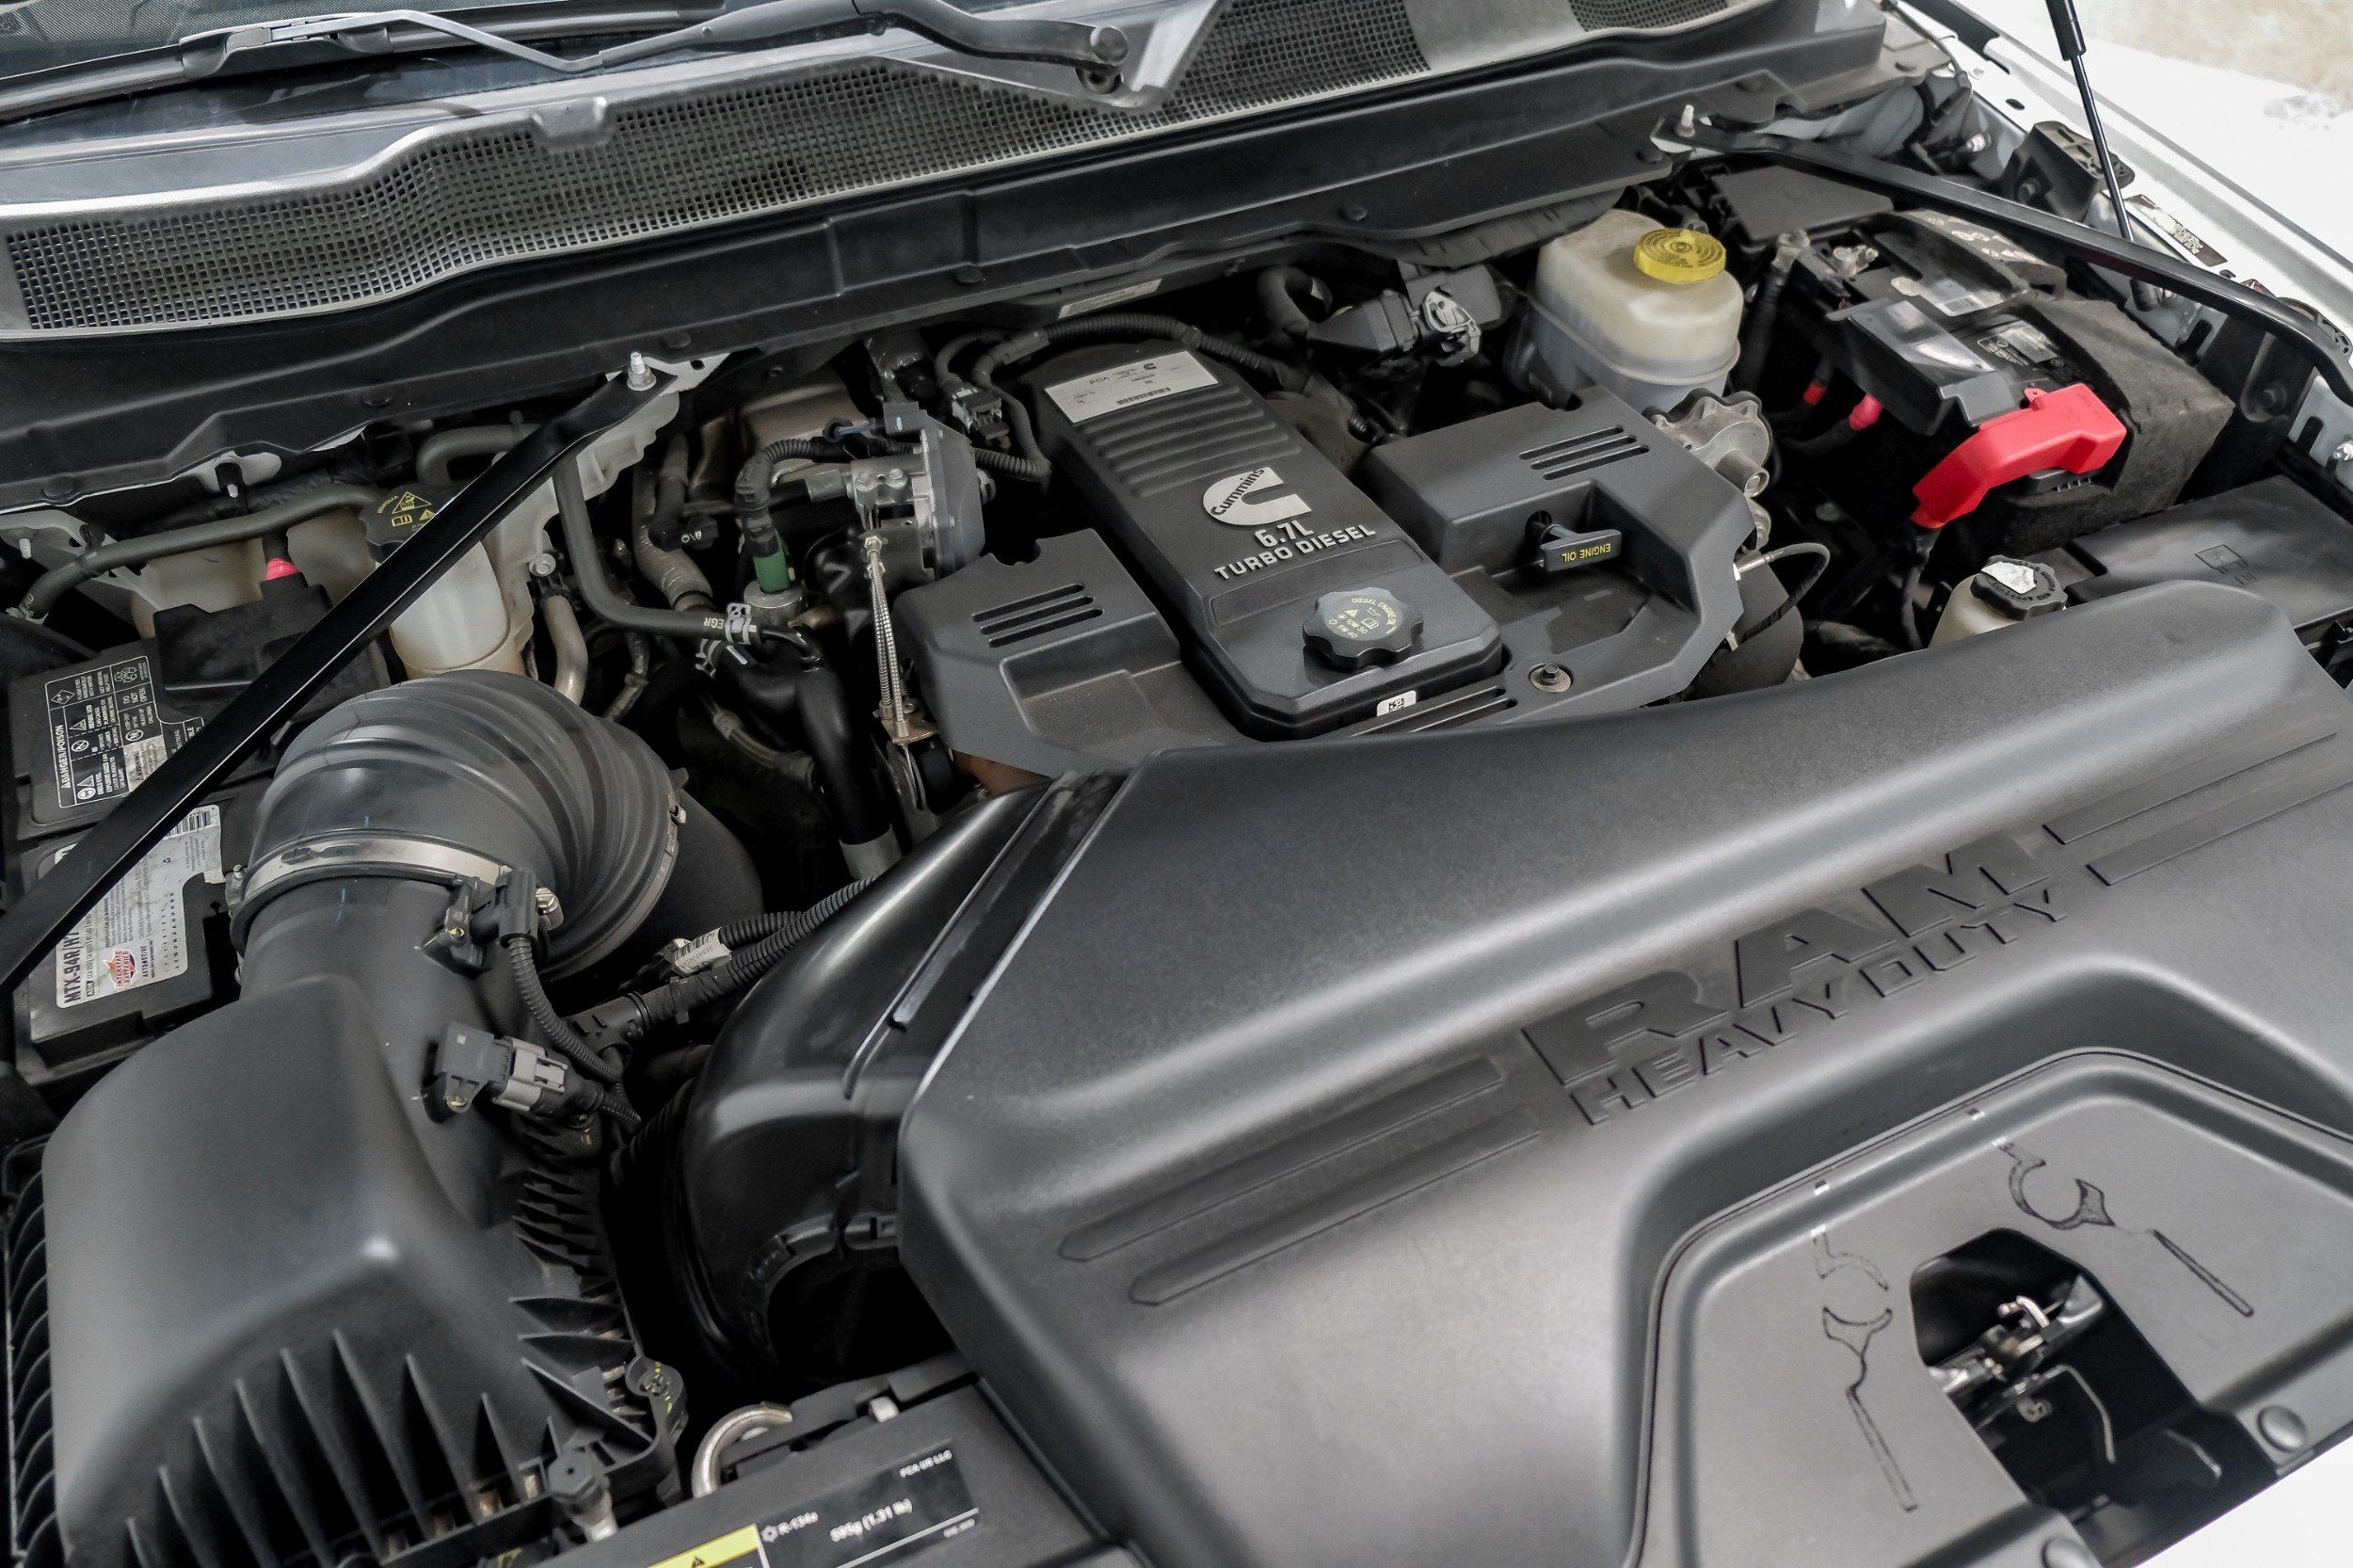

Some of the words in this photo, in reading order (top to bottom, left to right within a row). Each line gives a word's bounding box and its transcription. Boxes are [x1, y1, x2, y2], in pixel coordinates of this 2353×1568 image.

[1210, 469, 1265, 516] Cummins
[1255, 520, 1315, 548] 6.7L
[1579, 543, 1611, 559] ENGINE
[1214, 546, 1293, 581] TURBO
[1295, 524, 1376, 554] DIESEL
[1561, 552, 1577, 563] OIL
[703, 617, 725, 630] EGR
[1337, 624, 1358, 639] 5W-40
[56, 725, 71, 783] DANGER/POISON
[114, 951, 123, 986] INTERSTATE
[1520, 830, 2050, 1086] RAM
[1570, 979, 1849, 1126] HEAVY
[1860, 888, 2069, 998] DUTY
